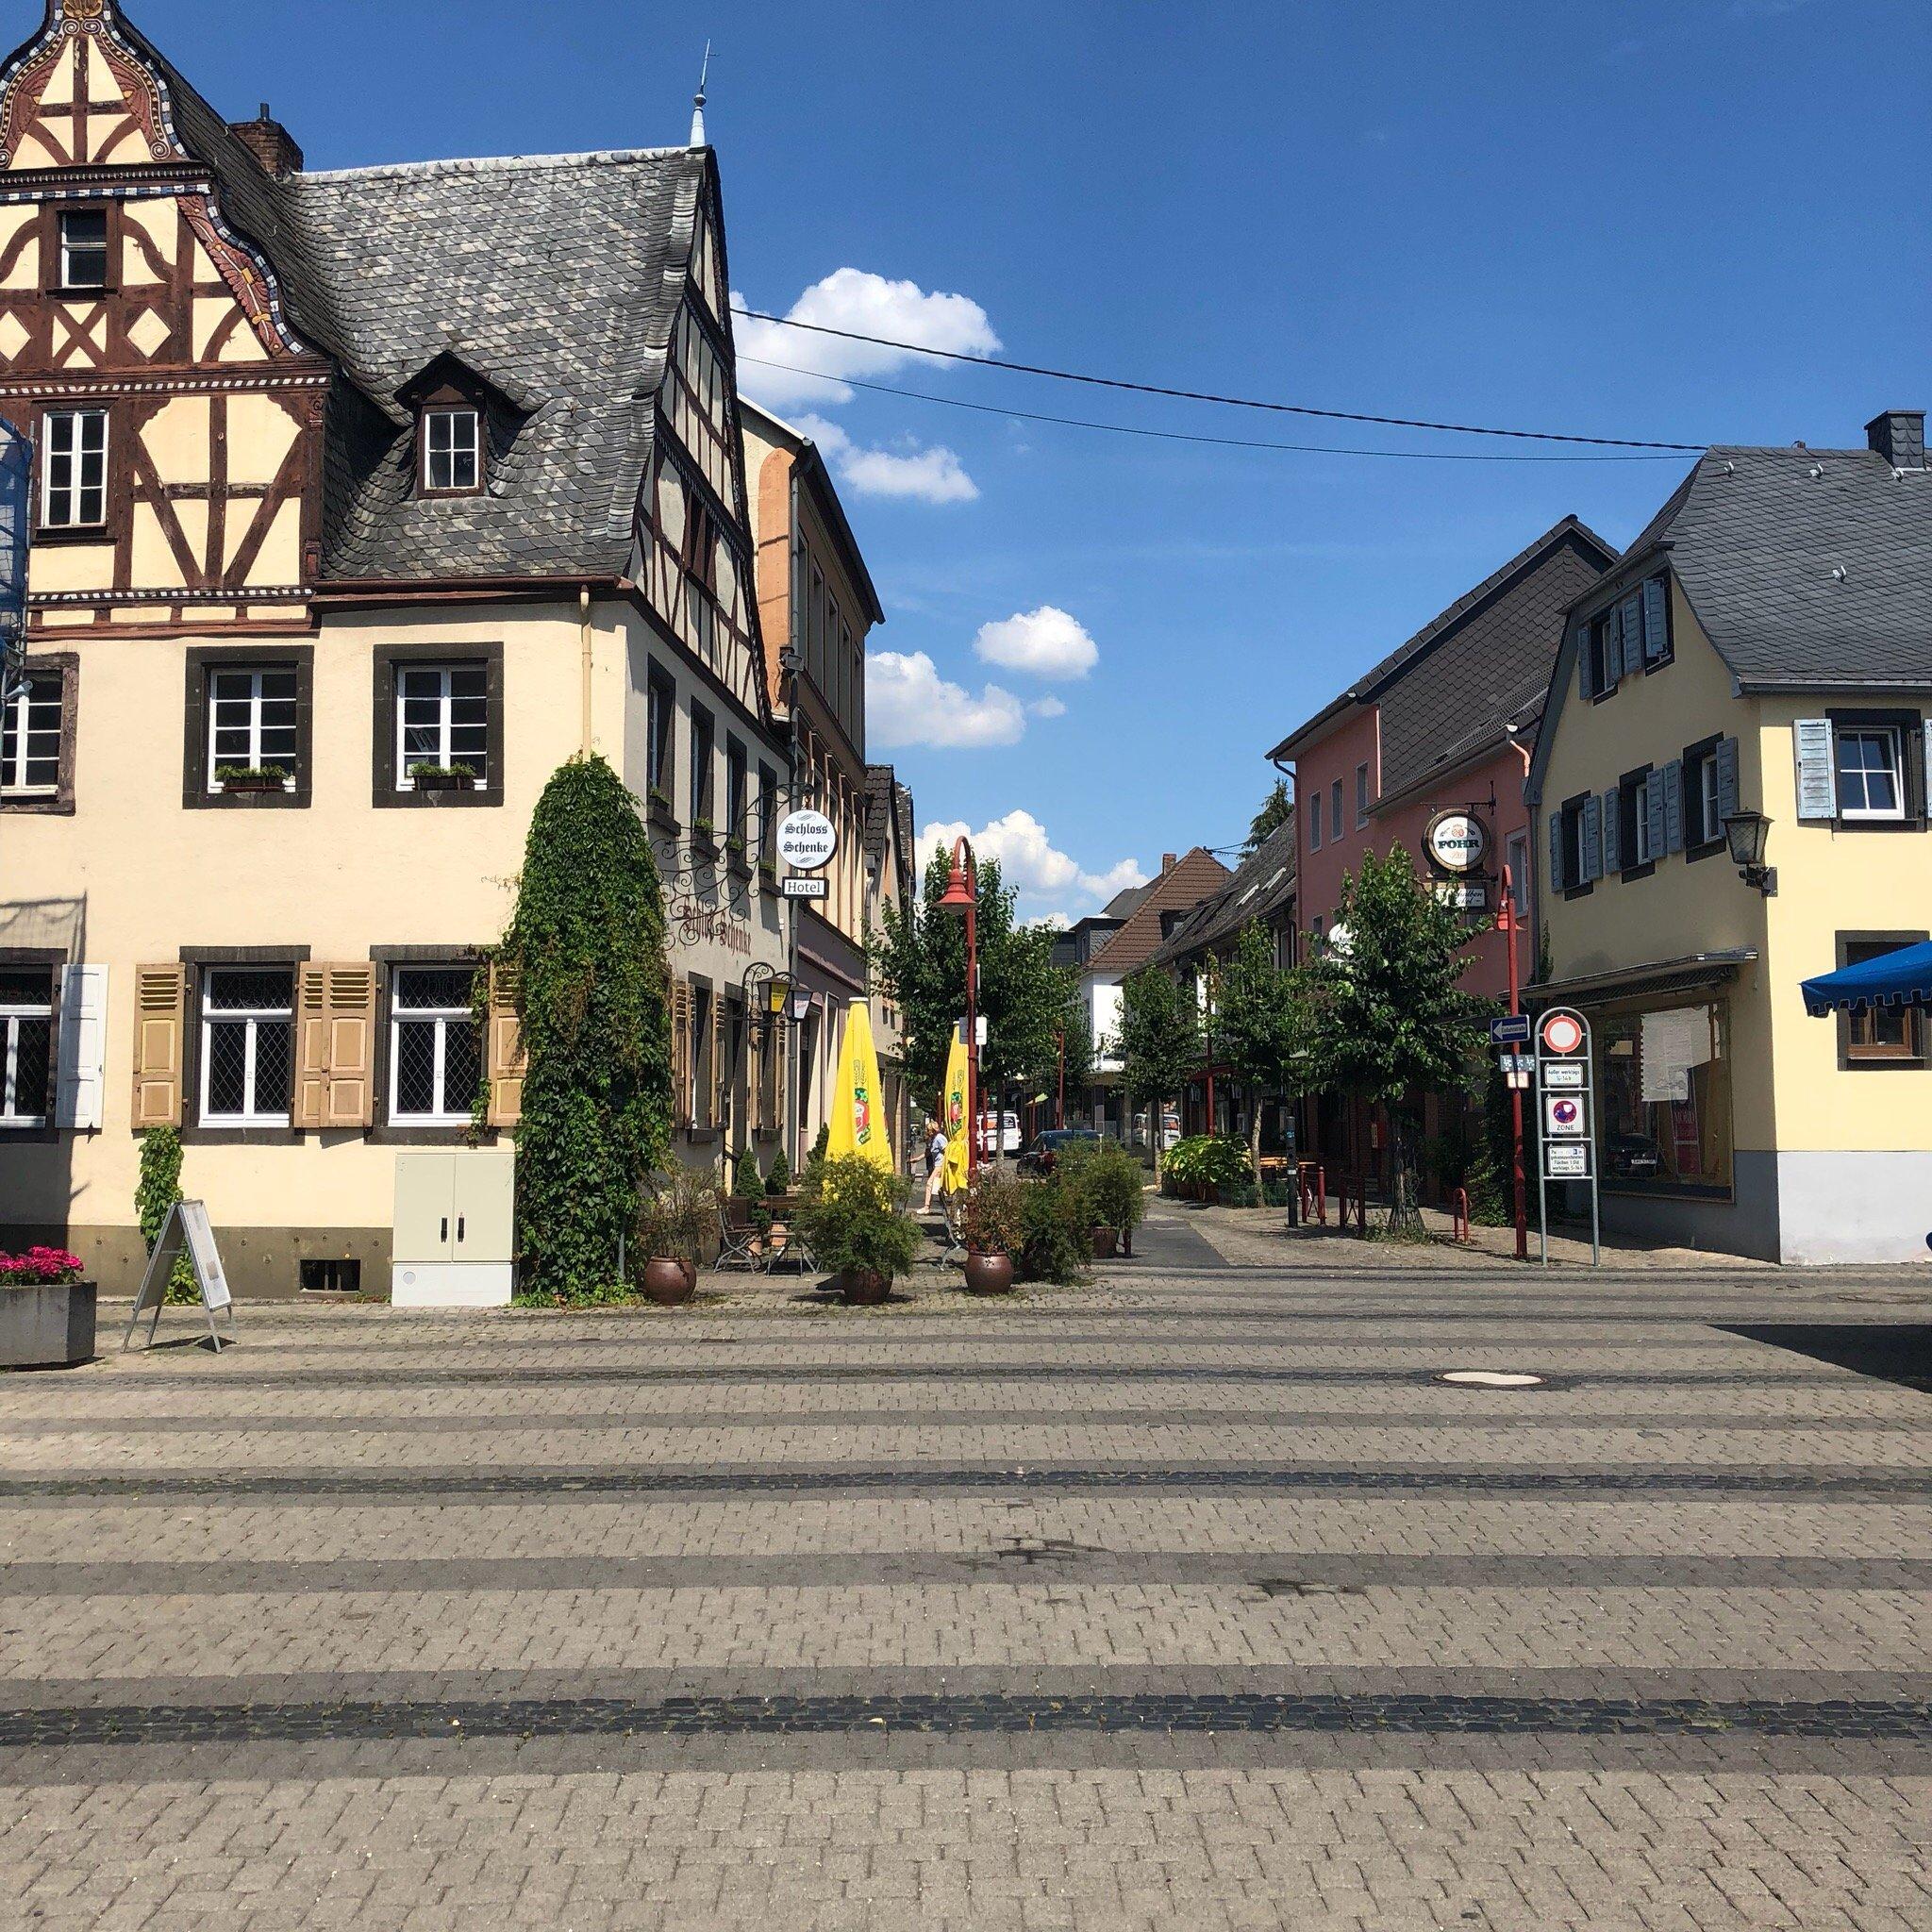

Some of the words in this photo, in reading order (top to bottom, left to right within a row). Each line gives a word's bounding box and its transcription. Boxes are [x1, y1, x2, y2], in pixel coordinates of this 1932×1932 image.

[785, 824, 828, 836] Schloss
[783, 841, 828, 854] Schenke
[1438, 839, 1479, 849] FOHR
[788, 881, 821, 892] Hotel
